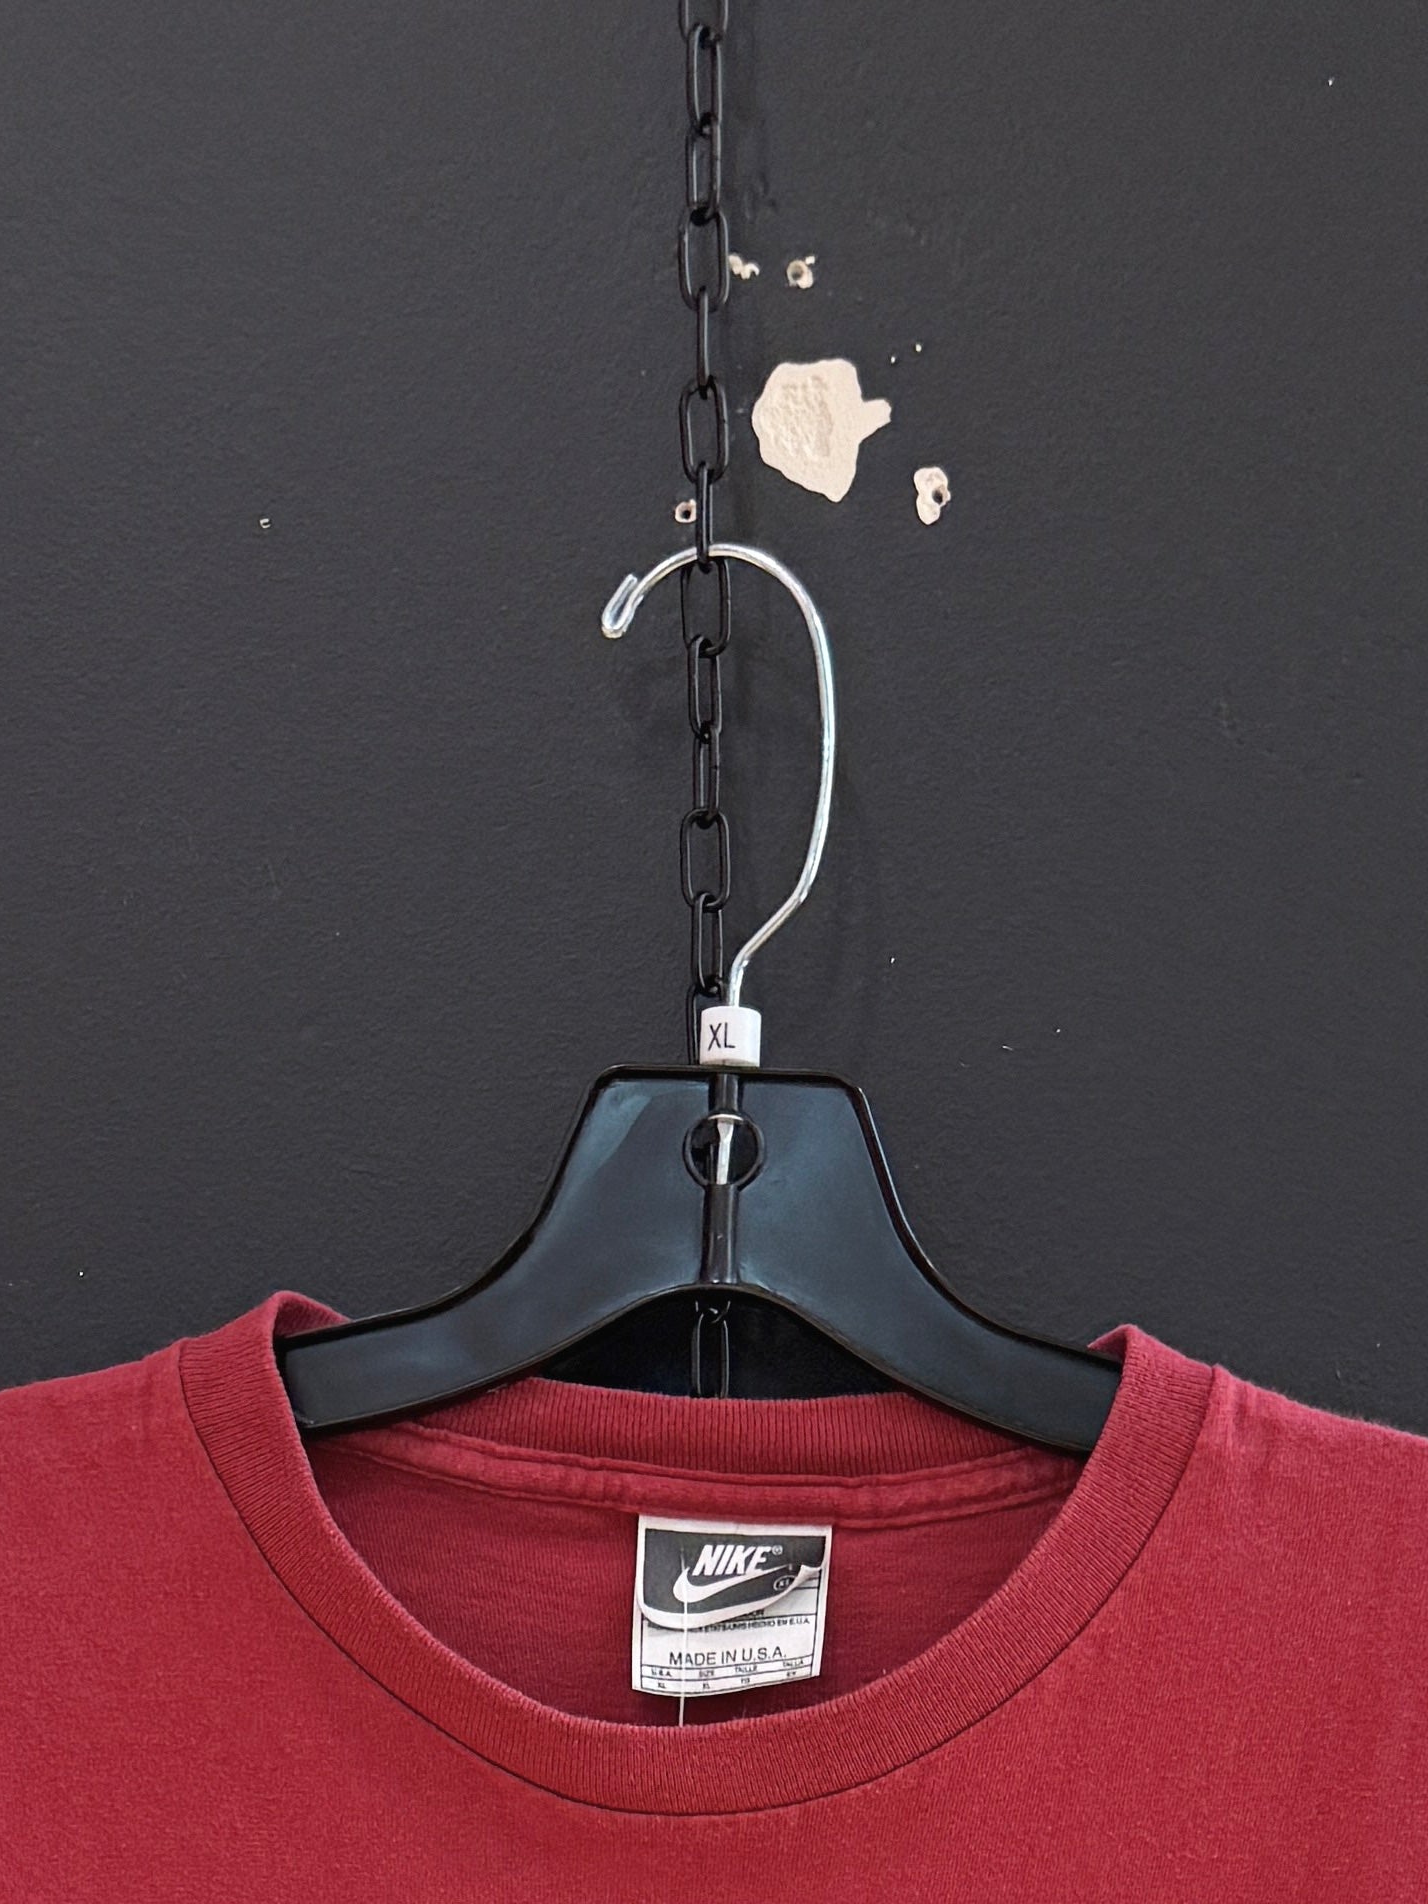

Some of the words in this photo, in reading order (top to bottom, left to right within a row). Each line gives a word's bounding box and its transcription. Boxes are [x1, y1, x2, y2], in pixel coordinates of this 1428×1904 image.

[707, 1022, 736, 1051] XL
[691, 1544, 772, 1576] NIKE
[669, 1651, 717, 1666] MADE
[722, 1649, 737, 1665] IN
[742, 1646, 787, 1663] U.S.A.
